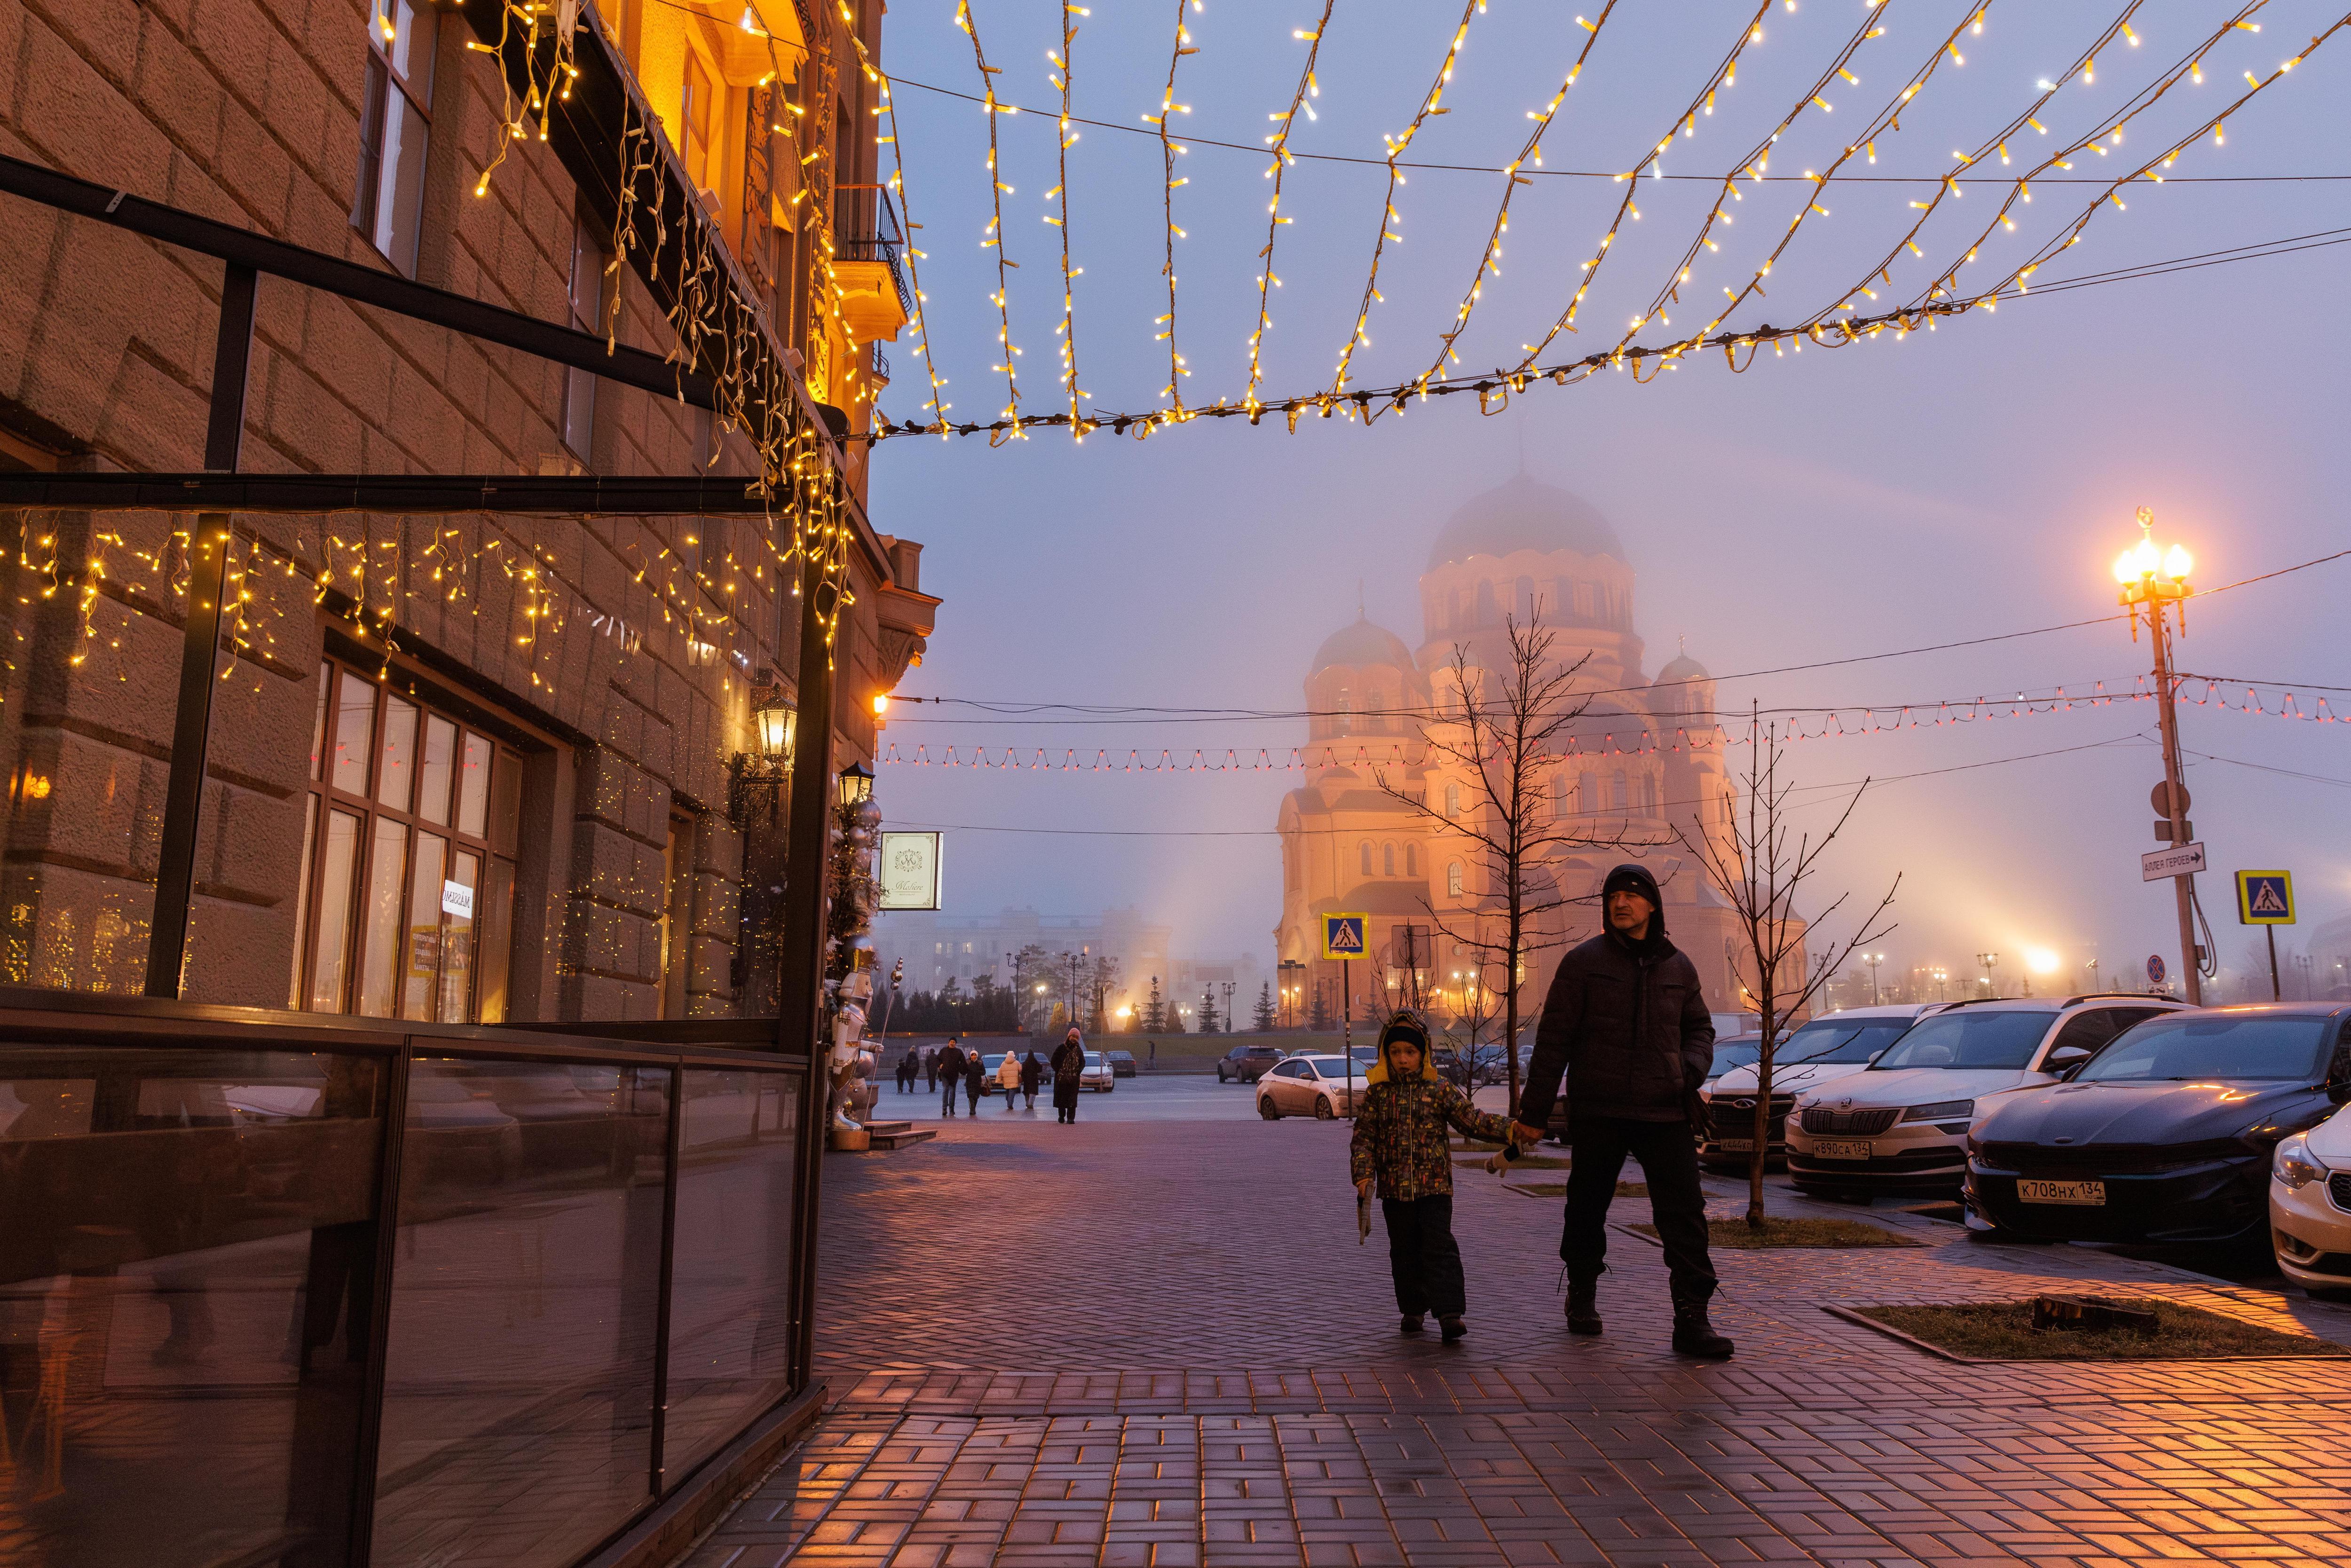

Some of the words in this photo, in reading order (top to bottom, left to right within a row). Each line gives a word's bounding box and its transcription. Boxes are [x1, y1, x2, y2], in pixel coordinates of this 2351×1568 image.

[2145, 860, 2164, 872] АЛЛЕЯ
[2166, 855, 2190, 868] ГЕРОЕВ
[1815, 1143, 1850, 1155] К890СА
[1852, 1143, 1868, 1152] 134
[2022, 1182, 2076, 1198] К708НХ
[2079, 1182, 2101, 1195] 134
